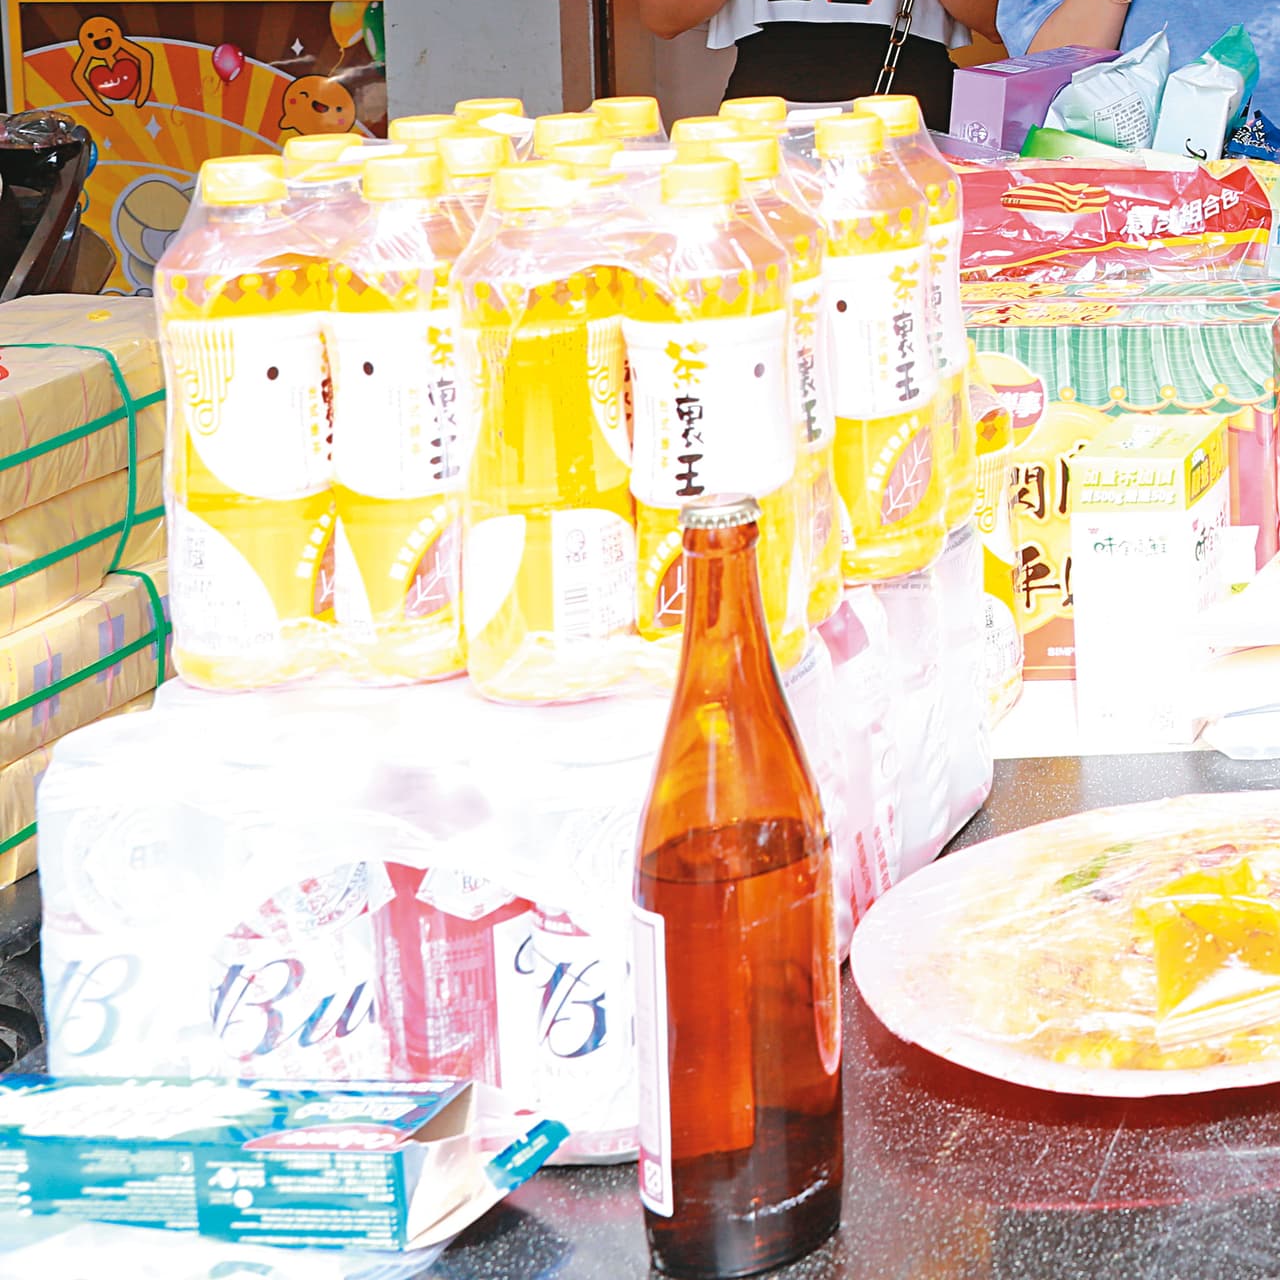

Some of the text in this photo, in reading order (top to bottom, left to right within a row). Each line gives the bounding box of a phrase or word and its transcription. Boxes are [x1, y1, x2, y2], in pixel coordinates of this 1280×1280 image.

[888, 260, 921, 403] 茶裏王
[664, 338, 709, 497] 茶裏王
